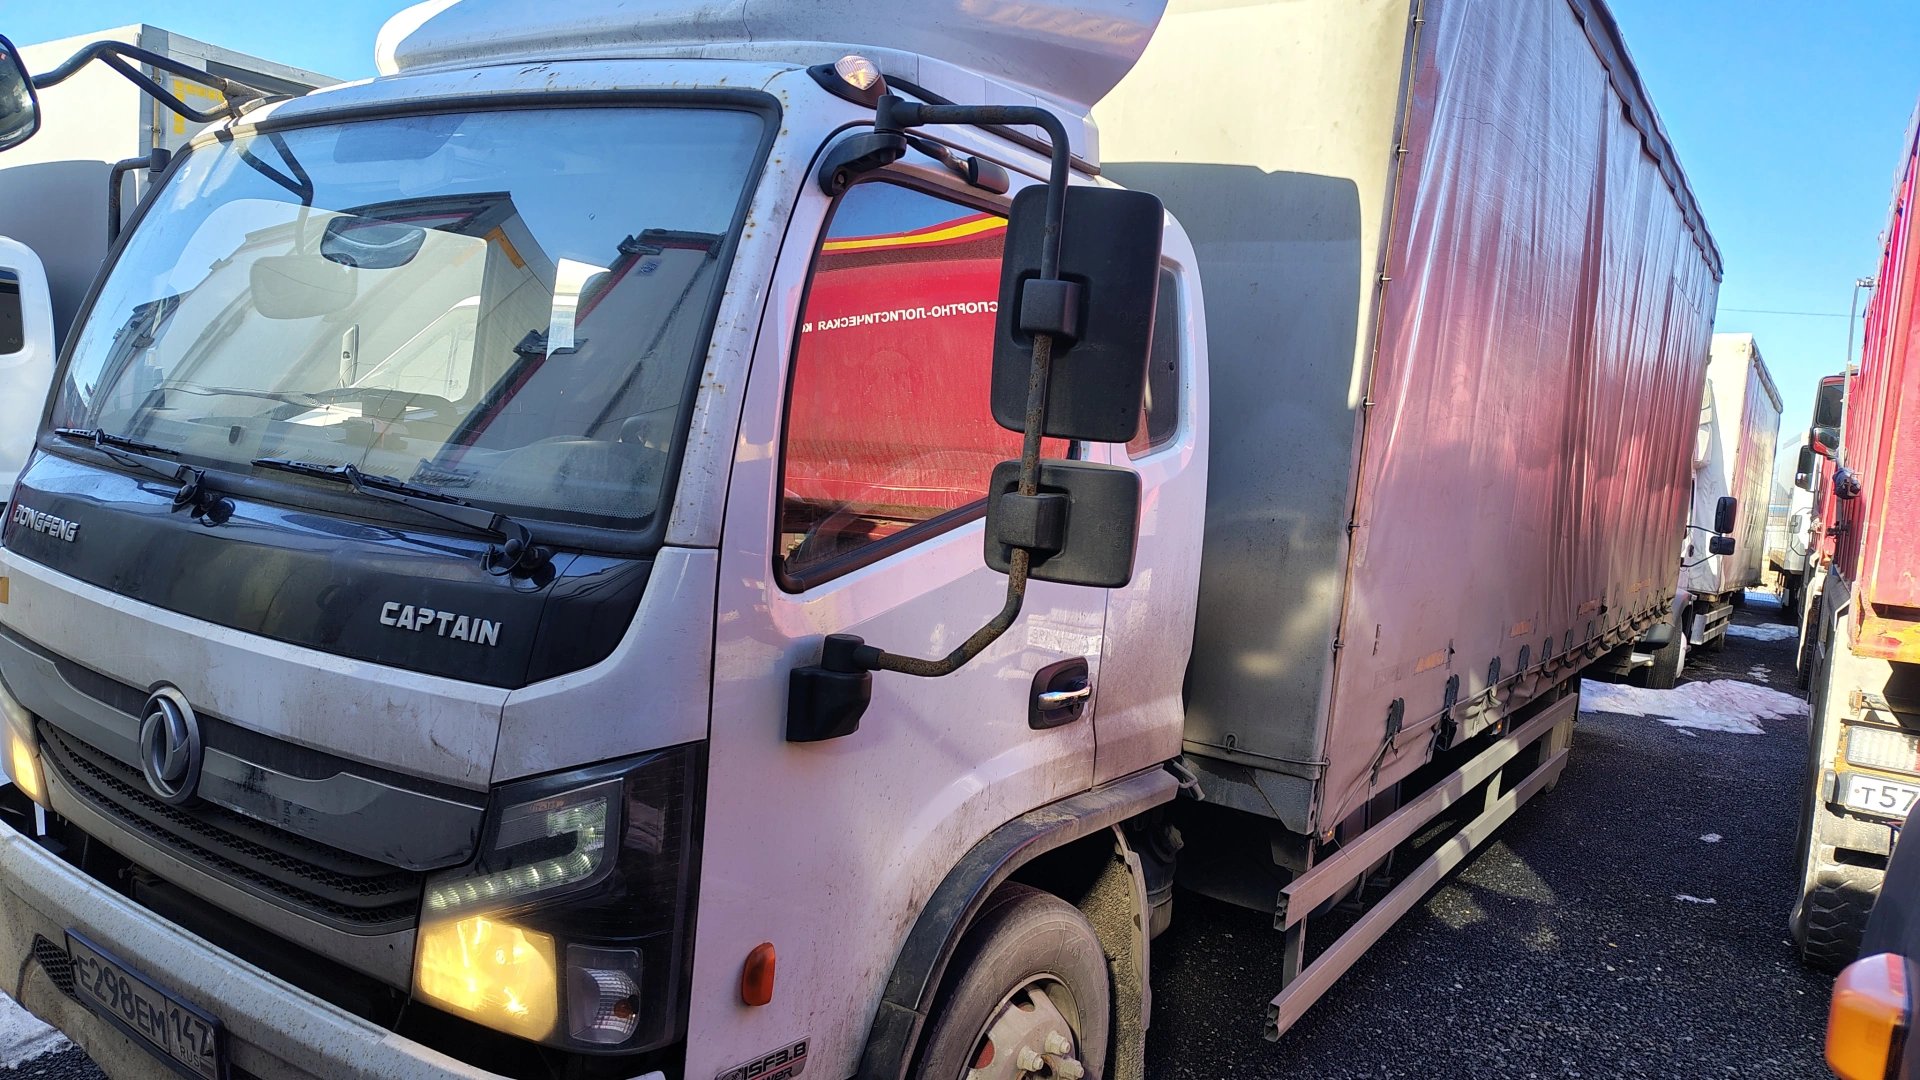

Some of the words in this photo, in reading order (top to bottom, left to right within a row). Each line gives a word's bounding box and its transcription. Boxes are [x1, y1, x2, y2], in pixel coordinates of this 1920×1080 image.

[14, 504, 79, 542] DONGFENG
[380, 601, 502, 646] CAPTAIN
[180, 1045, 200, 1068] RUS
